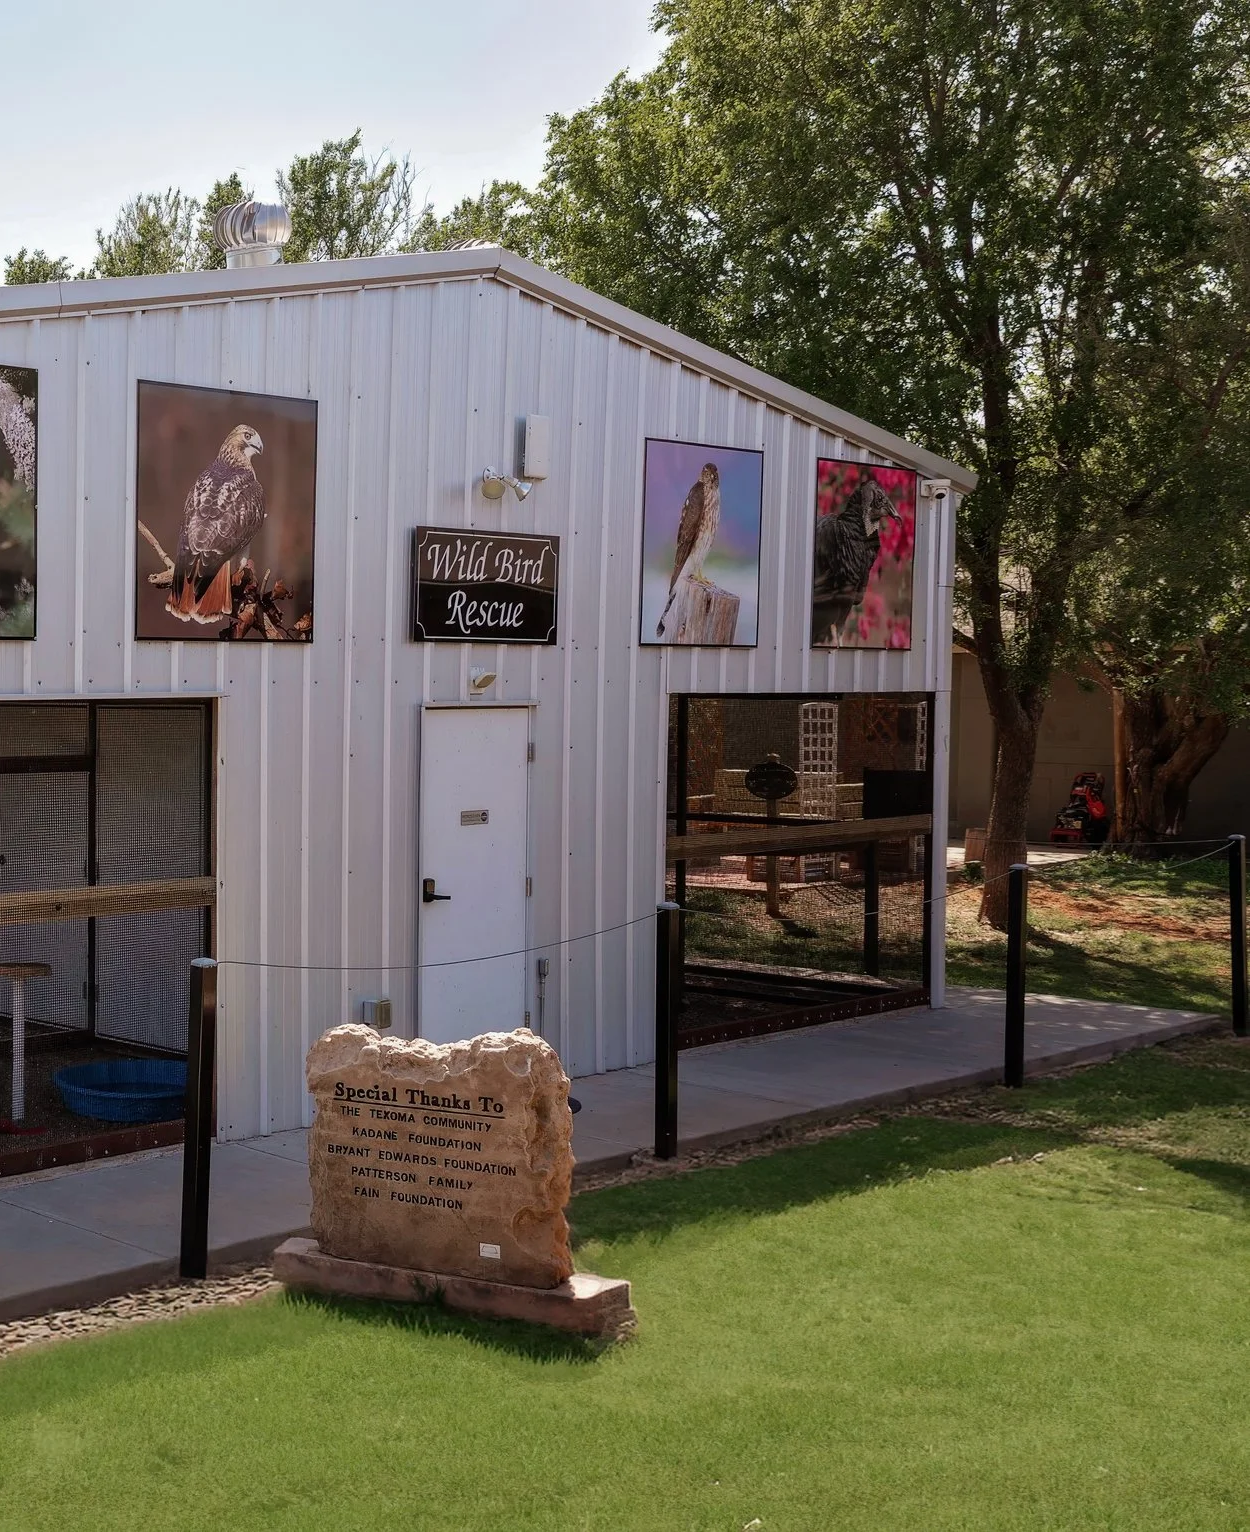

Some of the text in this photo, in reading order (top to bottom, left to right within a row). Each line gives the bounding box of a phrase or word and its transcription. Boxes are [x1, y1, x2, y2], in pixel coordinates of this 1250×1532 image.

[427, 538, 549, 585] Wild Bird
[445, 590, 524, 634] Rescue
[334, 1082, 504, 1114] Special Thanks To
[340, 1105, 492, 1132] THE TEXOMA COMMUNITY
[352, 1127, 482, 1152] KADANE FOUNDATION
[327, 1144, 517, 1176] BRYANT EDWARDS FOUNDATION
[351, 1166, 474, 1190] PATTERSON FAMILY
[354, 1187, 463, 1210] FAIN FOUNDATION
